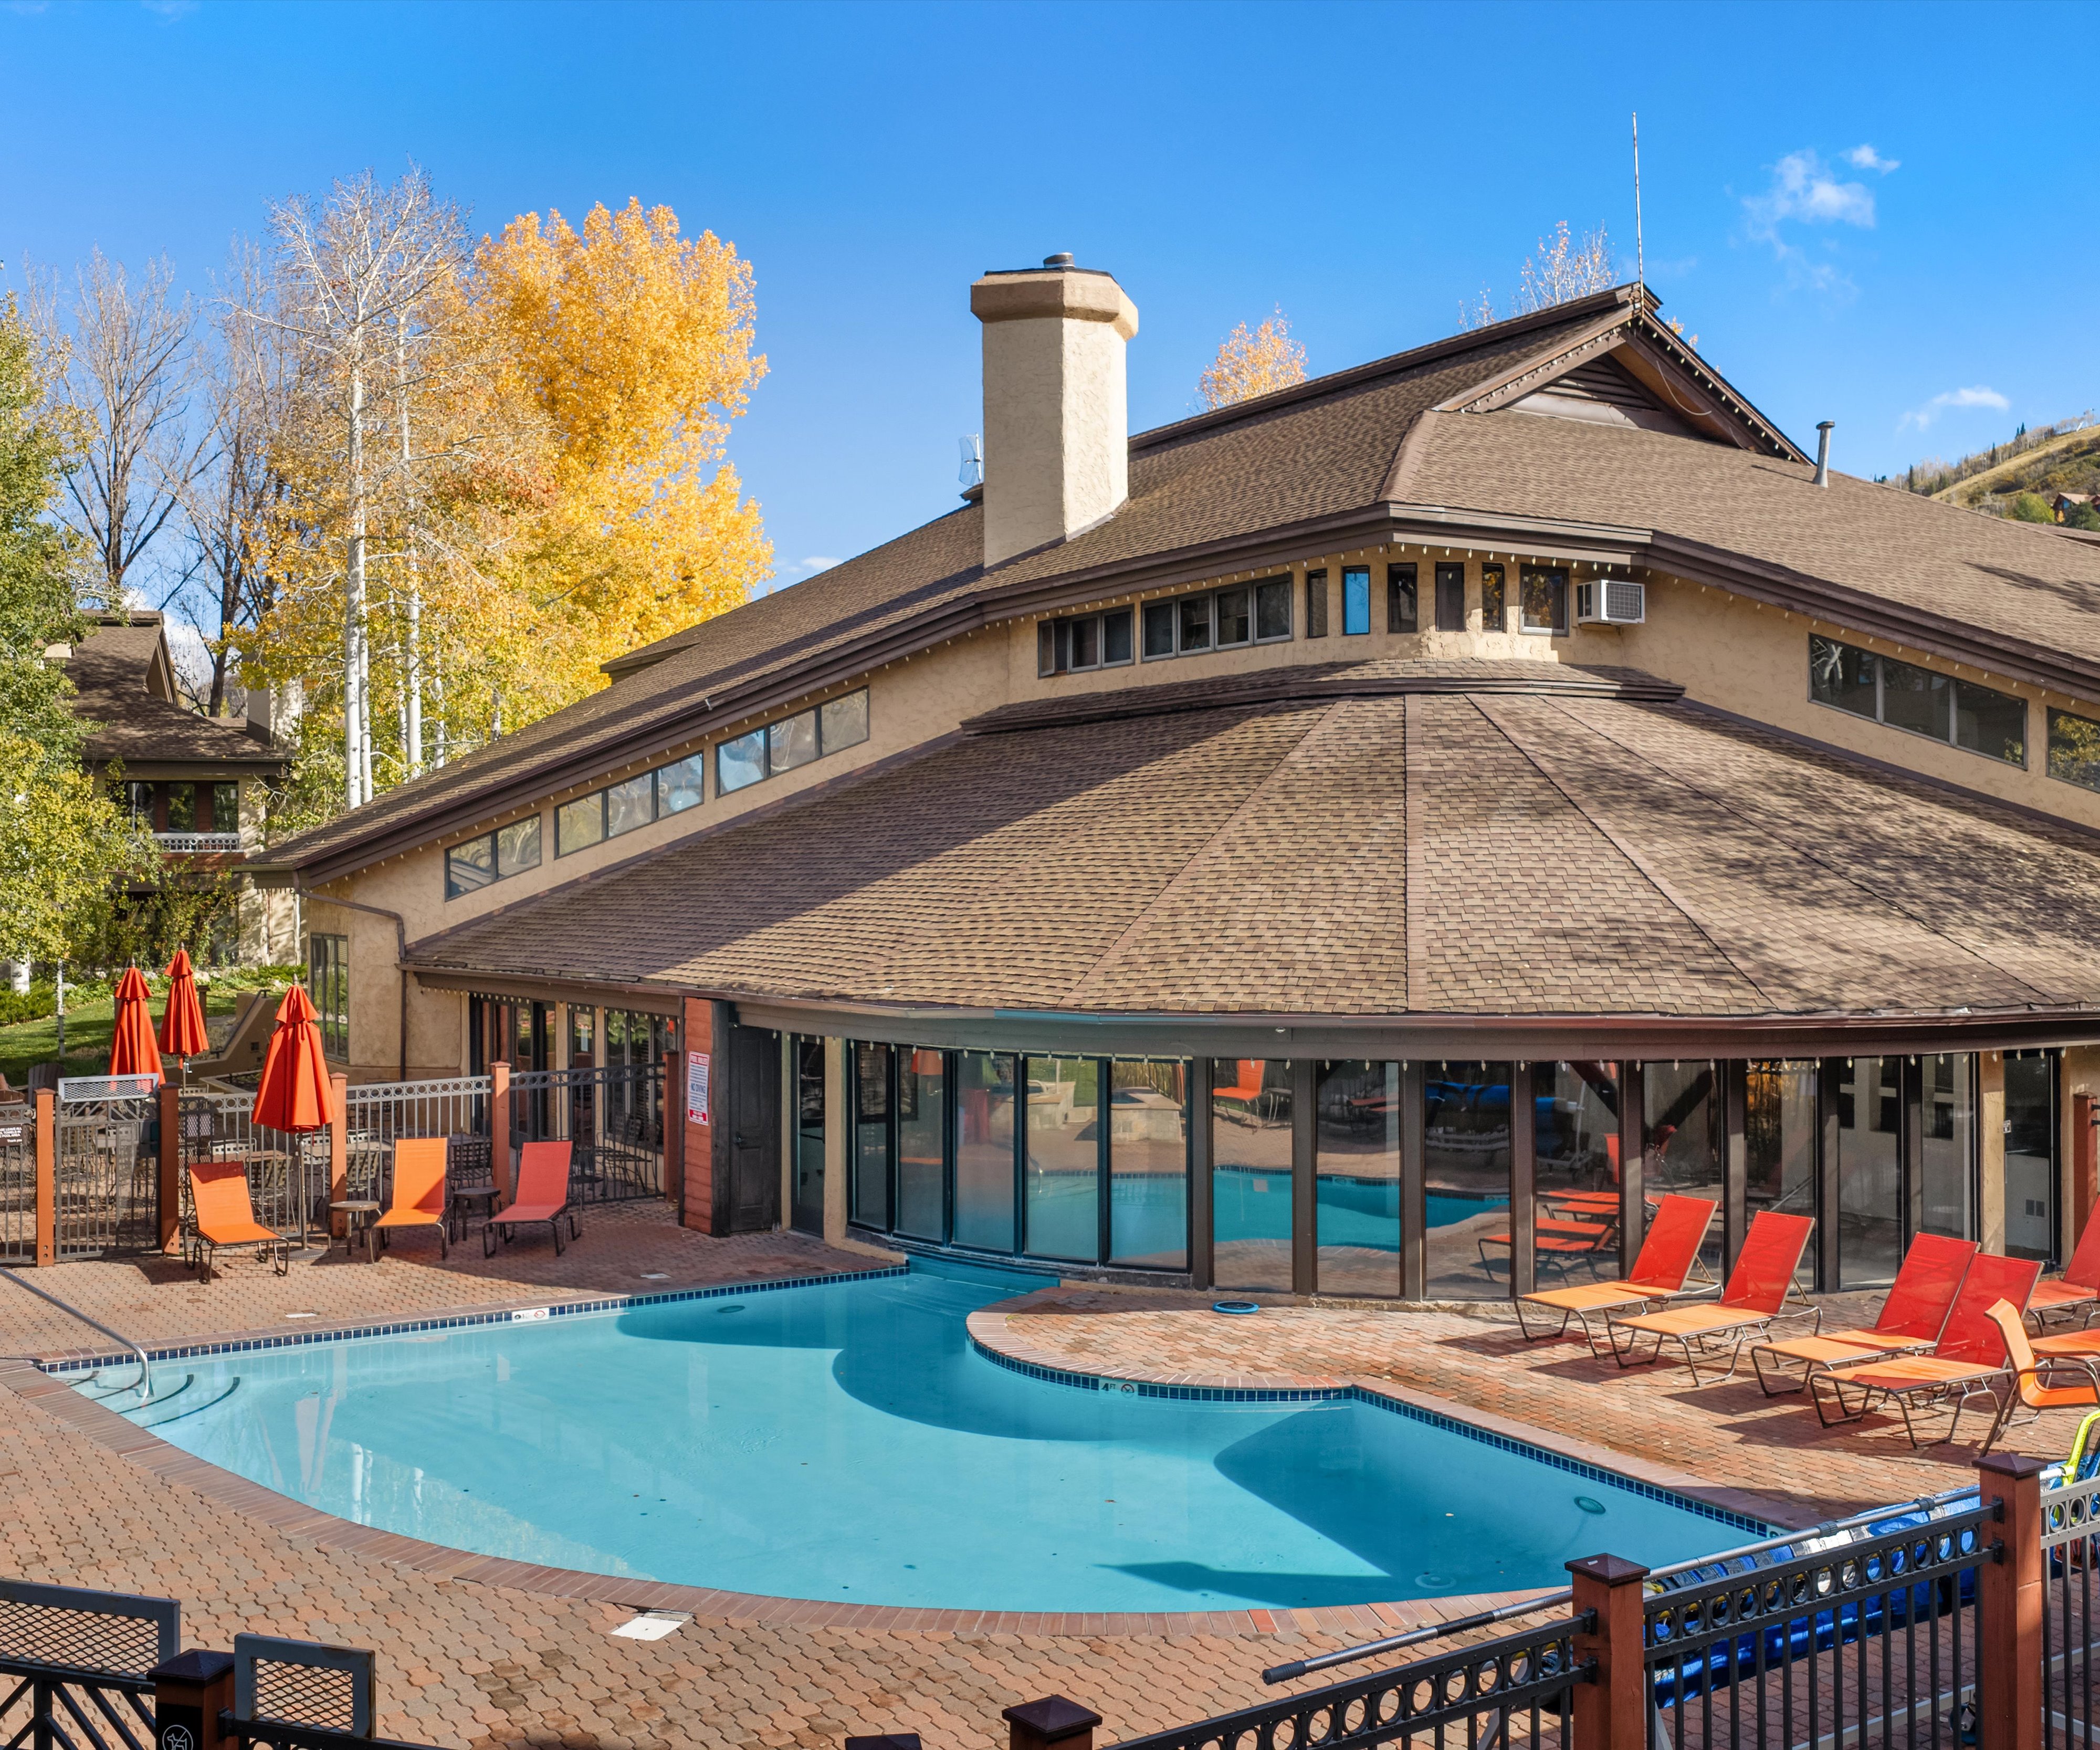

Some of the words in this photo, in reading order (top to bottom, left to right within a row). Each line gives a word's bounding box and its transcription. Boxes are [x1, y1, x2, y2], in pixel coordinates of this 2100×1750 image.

[691, 1083, 695, 1092] NO
[696, 1084, 706, 1094] DIVING
[1101, 1382, 1109, 1391] 4
